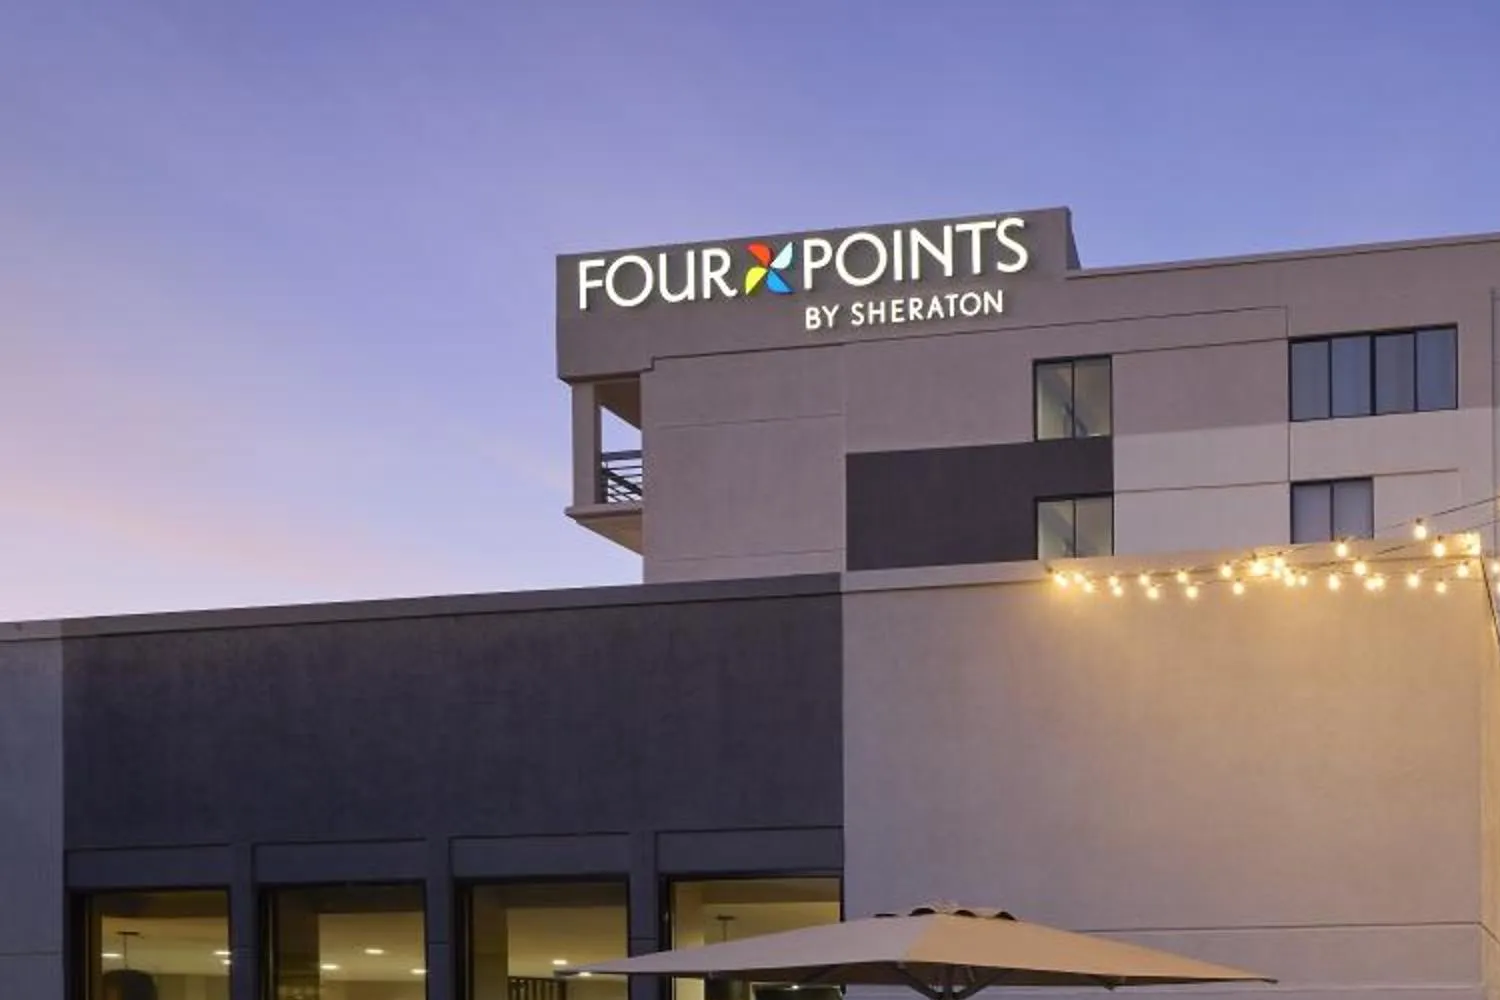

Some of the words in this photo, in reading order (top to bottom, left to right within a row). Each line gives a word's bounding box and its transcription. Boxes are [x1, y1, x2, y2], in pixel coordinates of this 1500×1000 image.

[578, 247, 738, 310] FOUR
[803, 217, 1029, 290] POINTS
[805, 304, 840, 331] BY
[850, 289, 1004, 327] SHERATON
